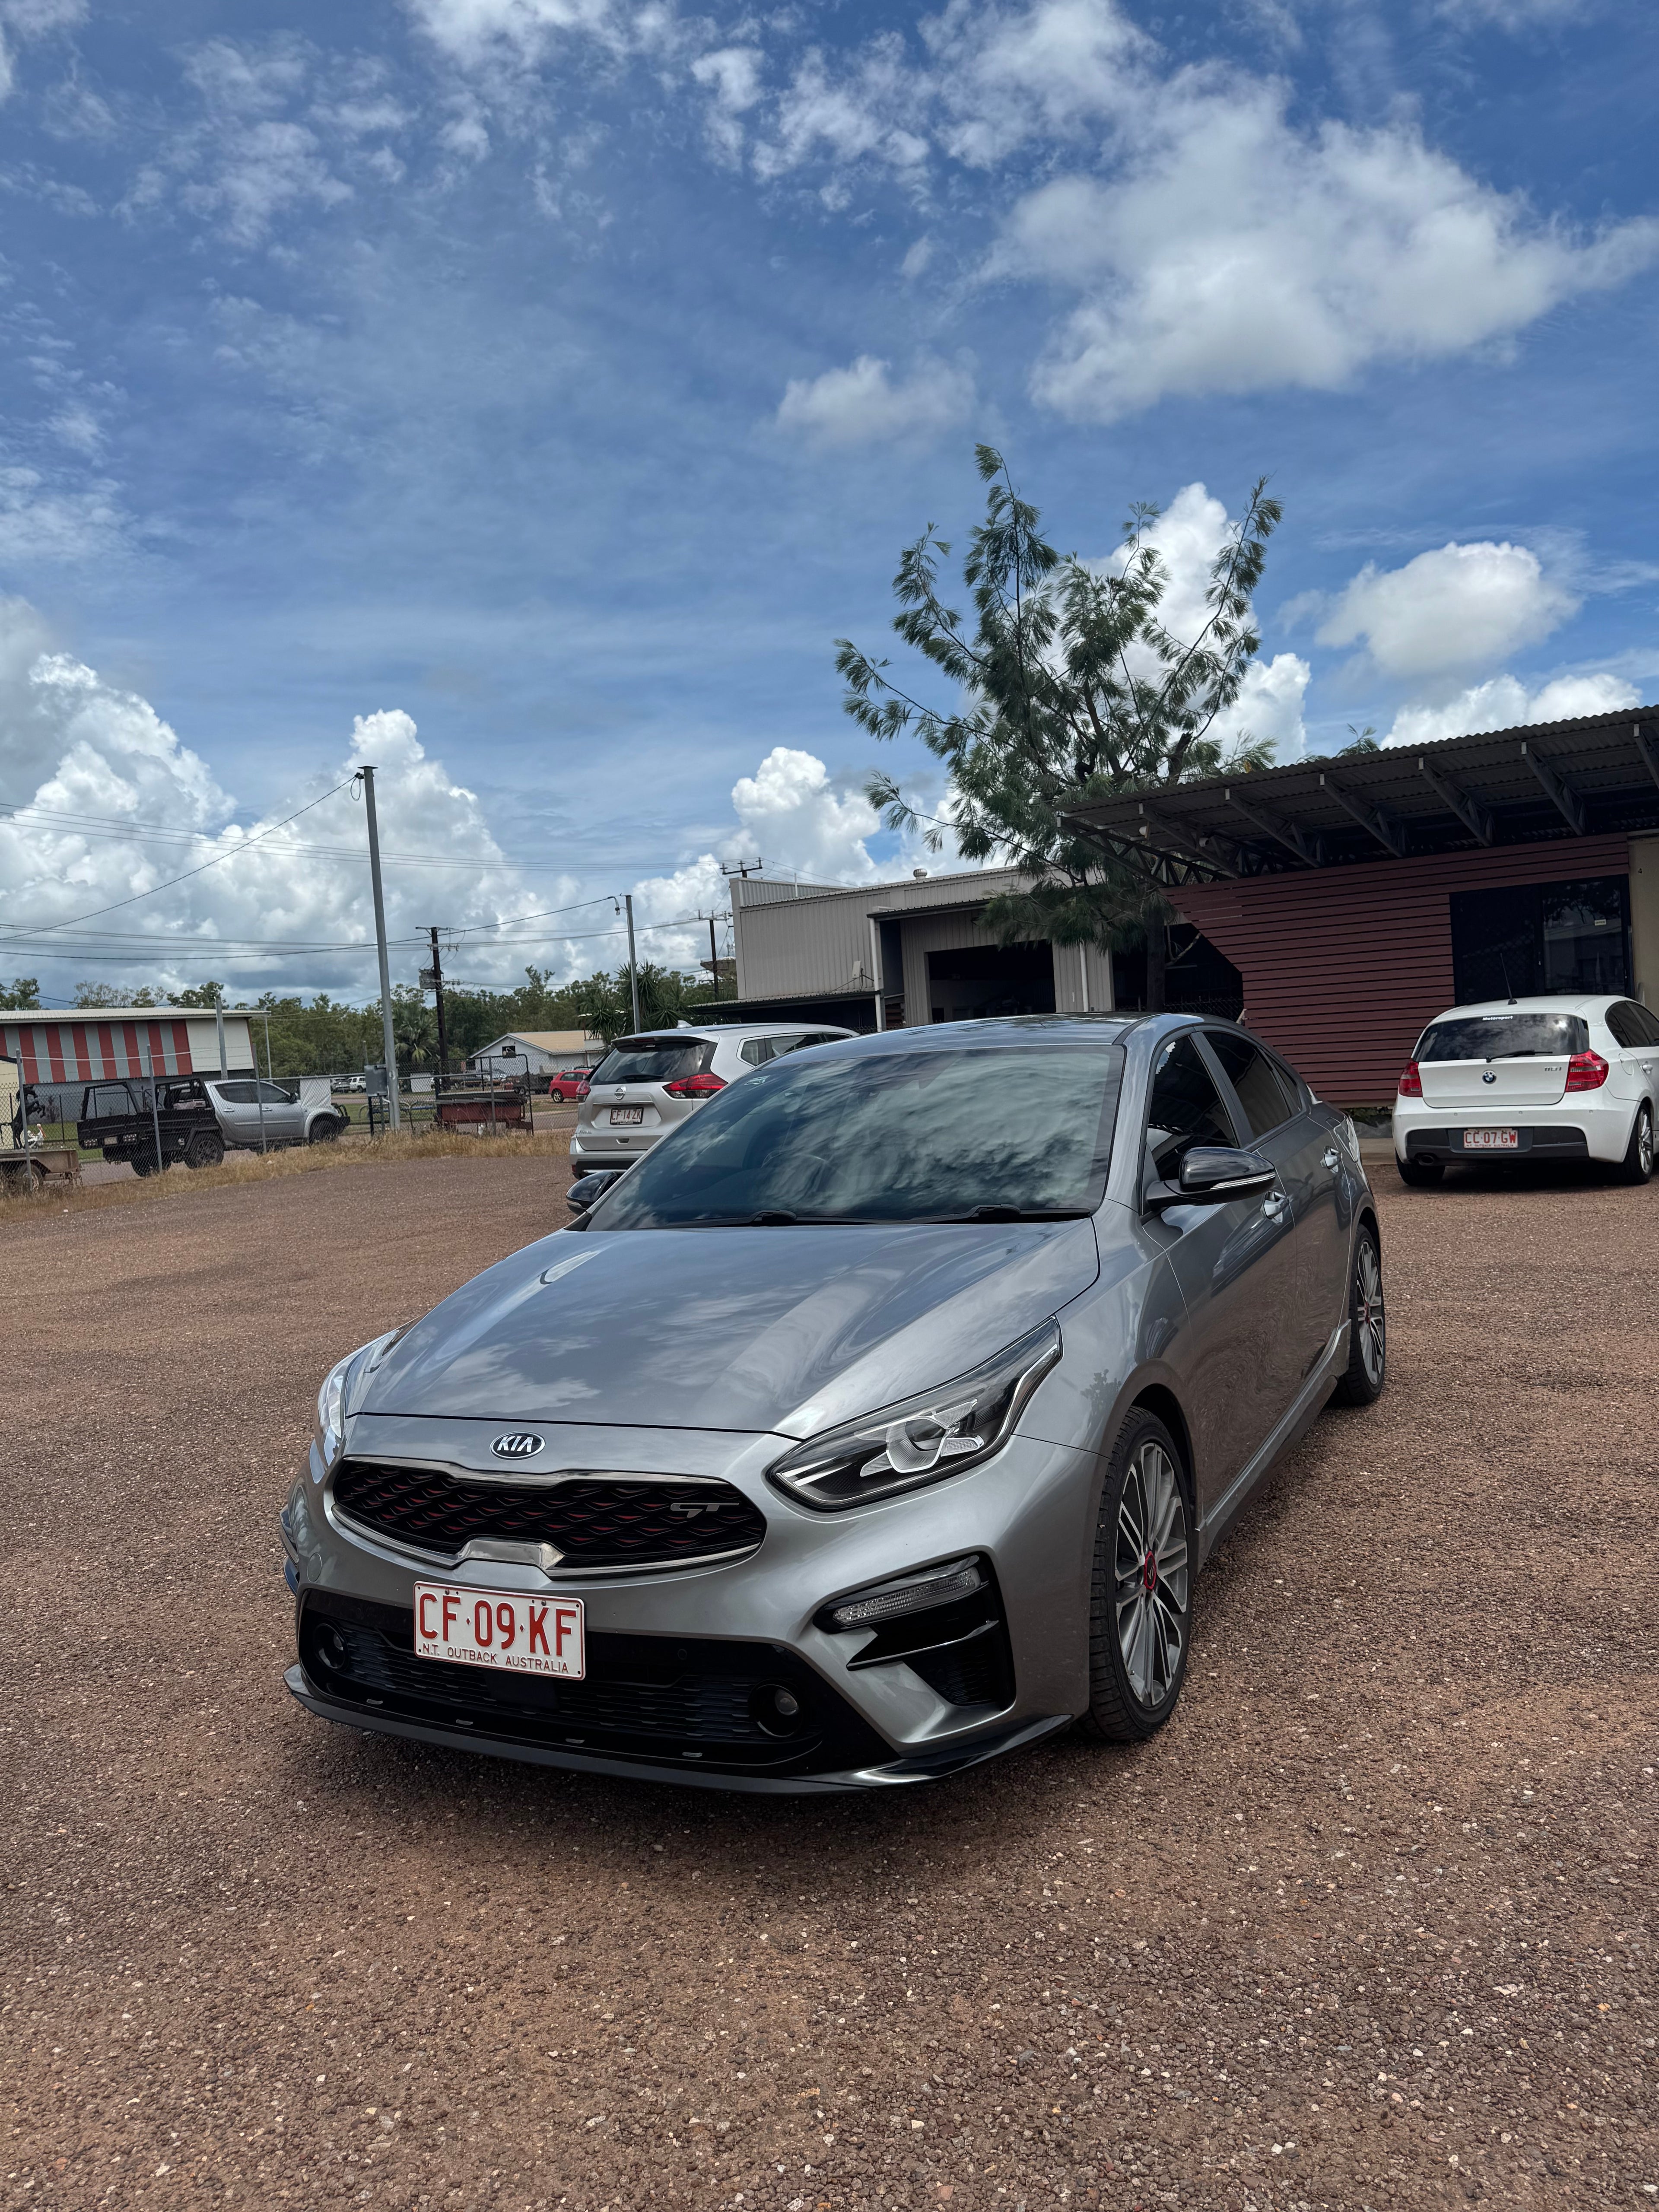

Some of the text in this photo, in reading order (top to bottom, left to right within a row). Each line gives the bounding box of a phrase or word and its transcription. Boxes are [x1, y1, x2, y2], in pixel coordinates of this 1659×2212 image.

[496, 1435, 534, 1453] KIA
[670, 1502, 740, 1519] GT
[423, 1643, 569, 1673] N.T. OUTBACK AUSTRALIA
